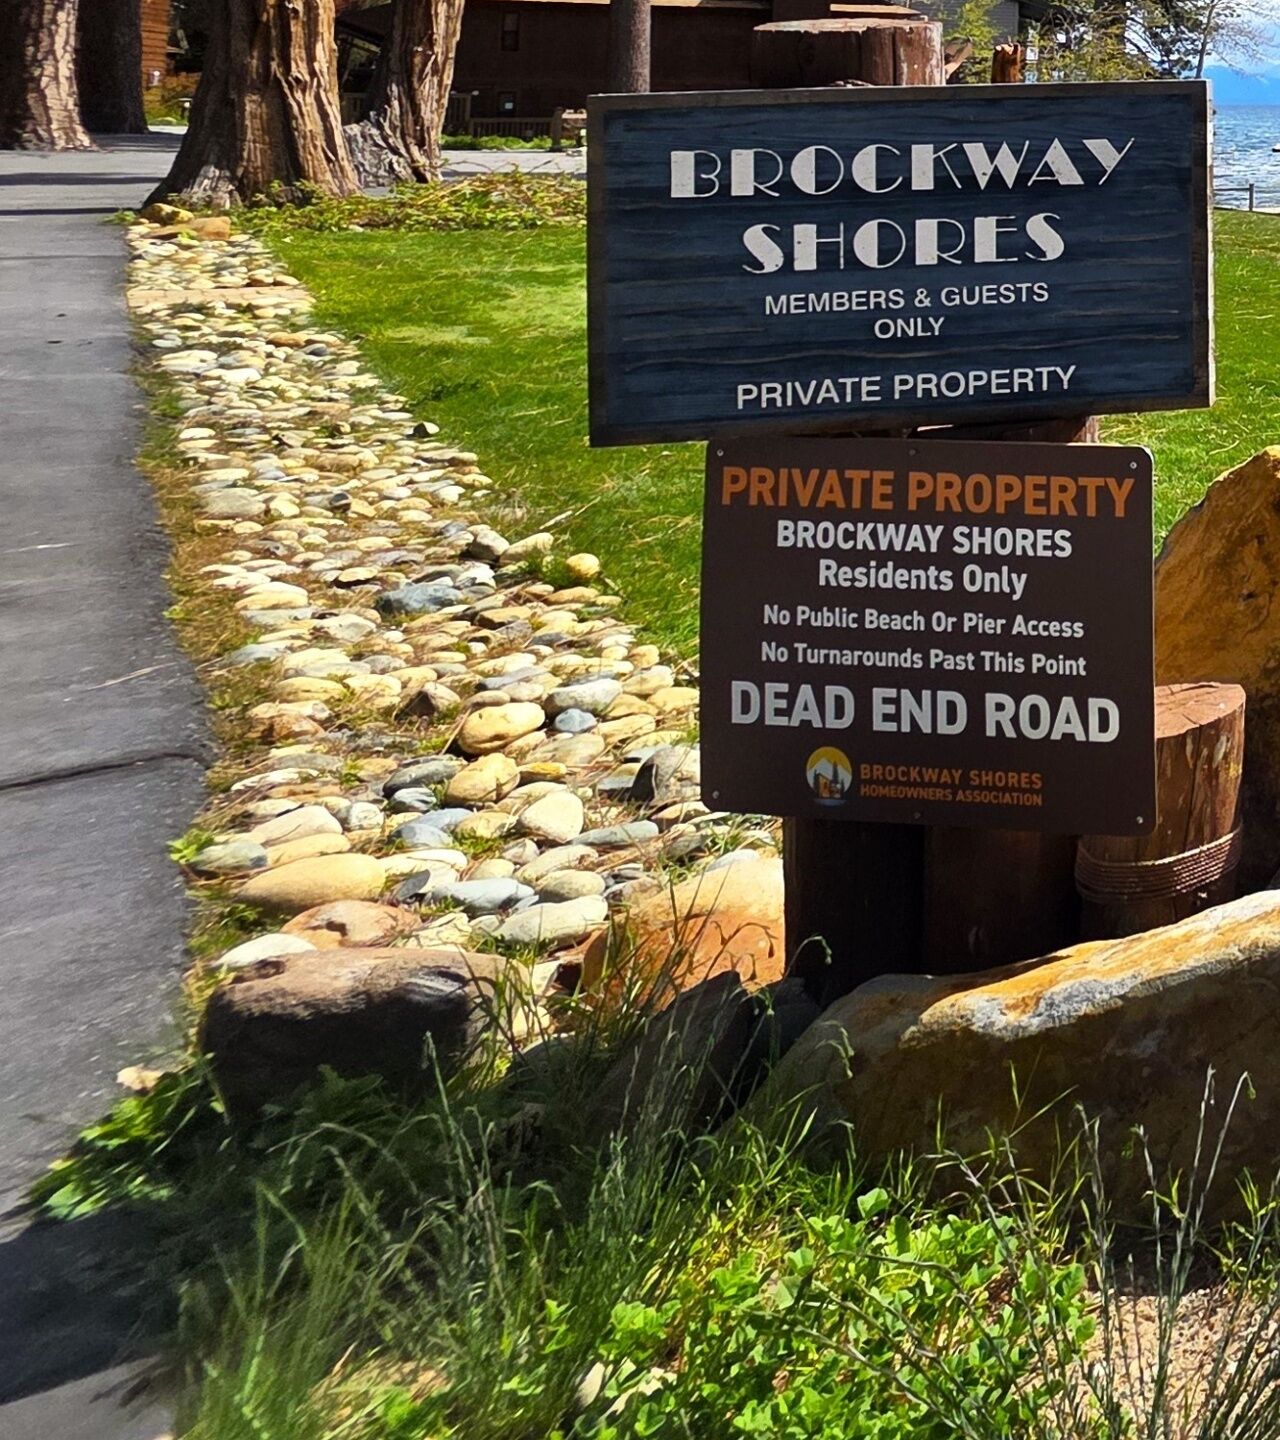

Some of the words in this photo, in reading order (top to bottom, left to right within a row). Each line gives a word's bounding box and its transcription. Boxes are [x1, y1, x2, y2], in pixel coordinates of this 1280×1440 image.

[670, 137, 1135, 199] BROCKWAY
[741, 212, 1065, 274] SHORES
[764, 289, 905, 315] MEMBERS
[914, 289, 932, 308] &
[940, 282, 1049, 307] GUESTS
[873, 316, 945, 338] ONLY
[736, 376, 881, 409] PRIVATE
[893, 365, 1076, 400] PROPERTY
[721, 466, 894, 509] PRIVATE
[907, 471, 1135, 518] PROPERTY
[776, 519, 943, 553] BROCKWAY
[952, 525, 1072, 557] SHORES
[819, 558, 953, 591] Residents
[963, 563, 1027, 600] Only
[763, 604, 790, 625] No
[797, 606, 859, 628] Public
[864, 609, 925, 632] Beach
[932, 611, 957, 632] Or
[963, 613, 1006, 634] Pier
[1012, 615, 1084, 638] Access
[761, 641, 788, 663] No
[794, 643, 923, 668] Turnarounds
[930, 649, 975, 671] Past
[980, 651, 1025, 674] This
[1032, 654, 1087, 676] Point
[731, 680, 855, 730] DEAD
[872, 687, 968, 734] END
[985, 693, 1120, 743] ROAD
[859, 763, 963, 785] BROCKWAY
[969, 770, 1042, 789] SHORES
[859, 784, 952, 802] HOMEOWNERS
[956, 789, 1042, 807] ASSOCIATION
